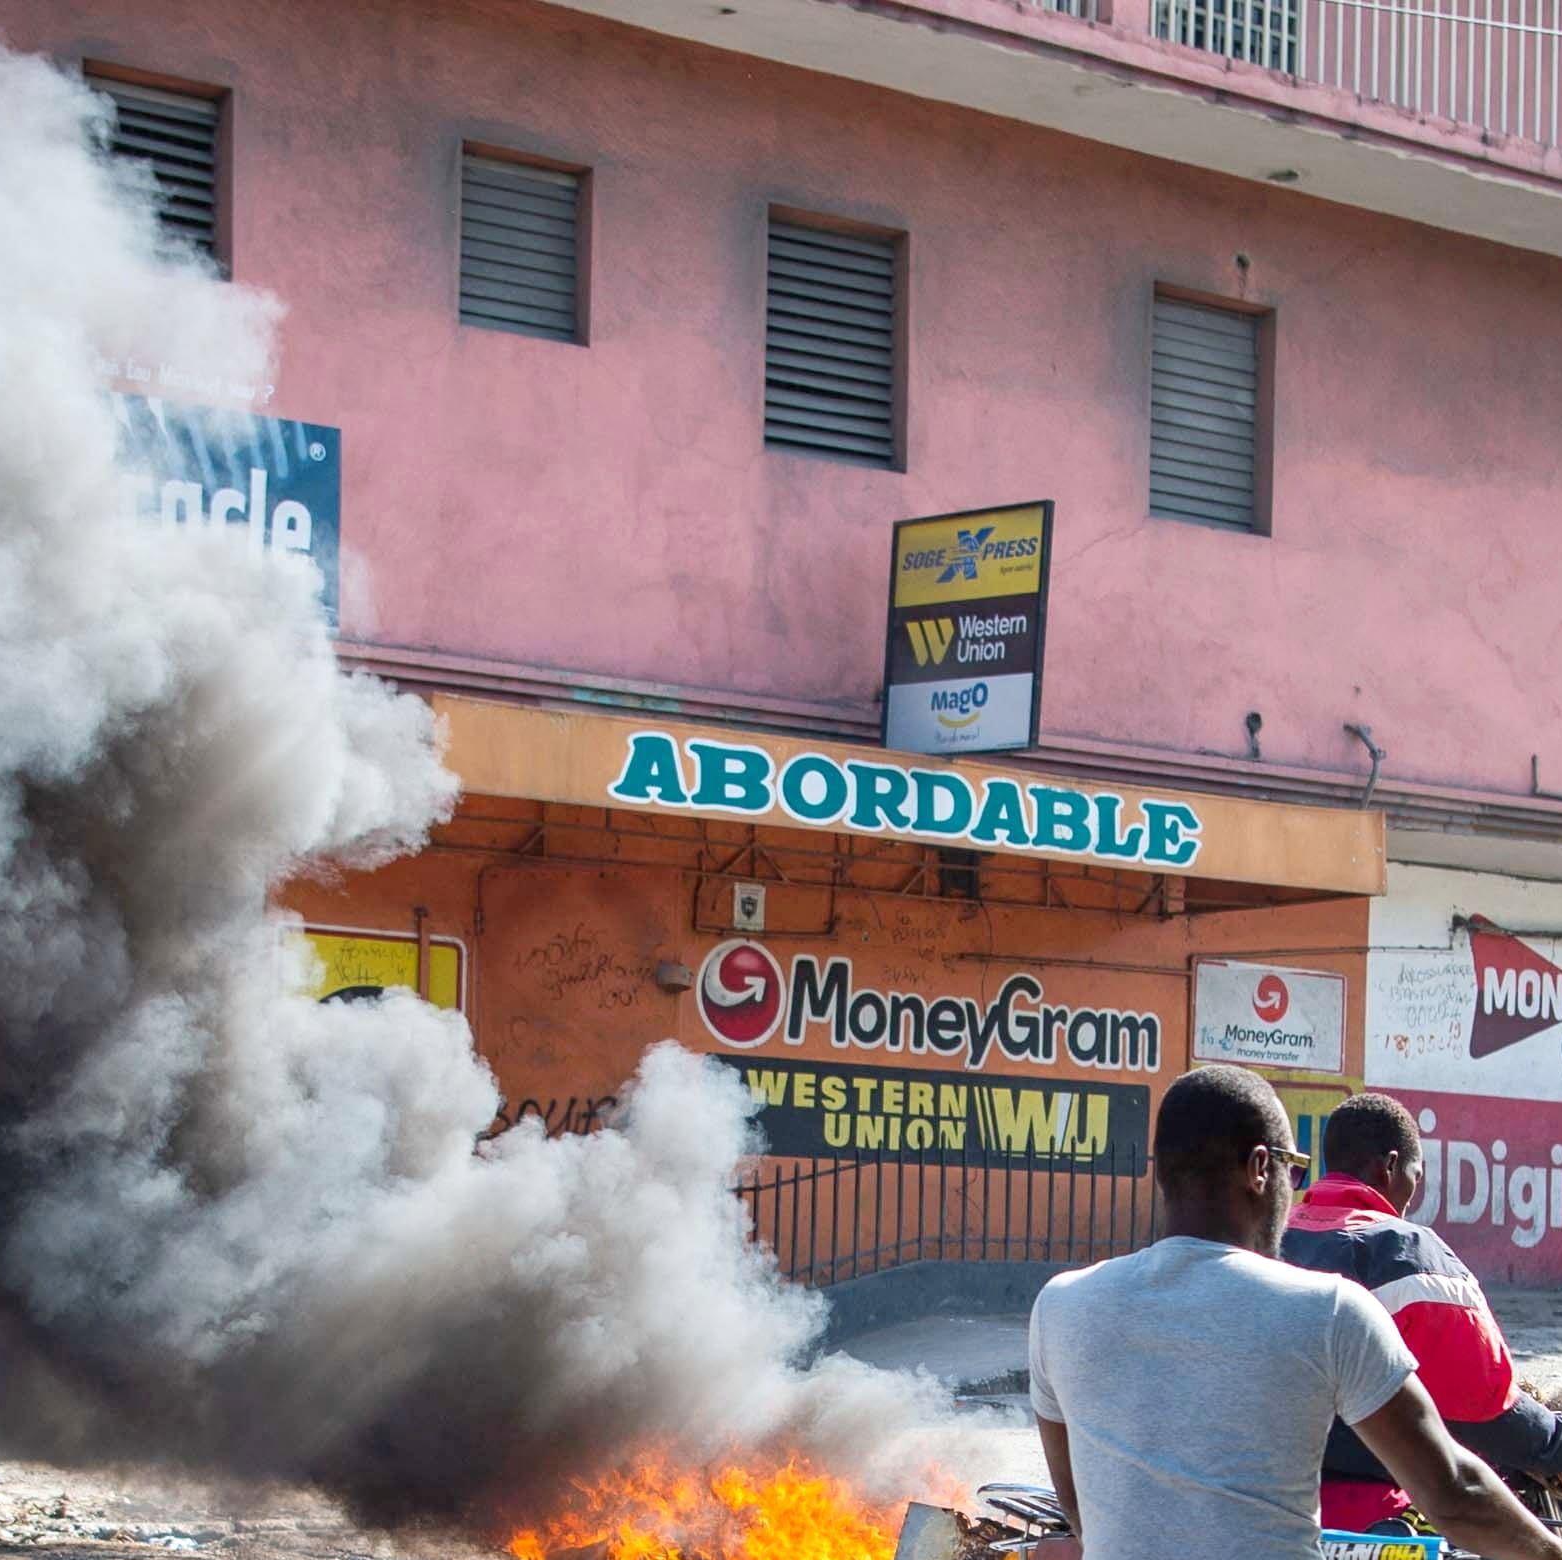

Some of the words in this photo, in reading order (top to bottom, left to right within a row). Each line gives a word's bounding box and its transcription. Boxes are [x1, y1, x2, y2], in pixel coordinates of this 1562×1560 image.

[957, 614, 1028, 640] Western
[957, 639, 1006, 663] Union
[609, 732, 1203, 868] ABORDABLE
[785, 954, 1161, 1072] MoneyGram
[1225, 1023, 1313, 1050] MoneyGram
[1236, 1048, 1266, 1061] money
[1267, 1050, 1300, 1062] transfer
[747, 1070, 968, 1119] WESTERN
[823, 1112, 966, 1152] UNION
